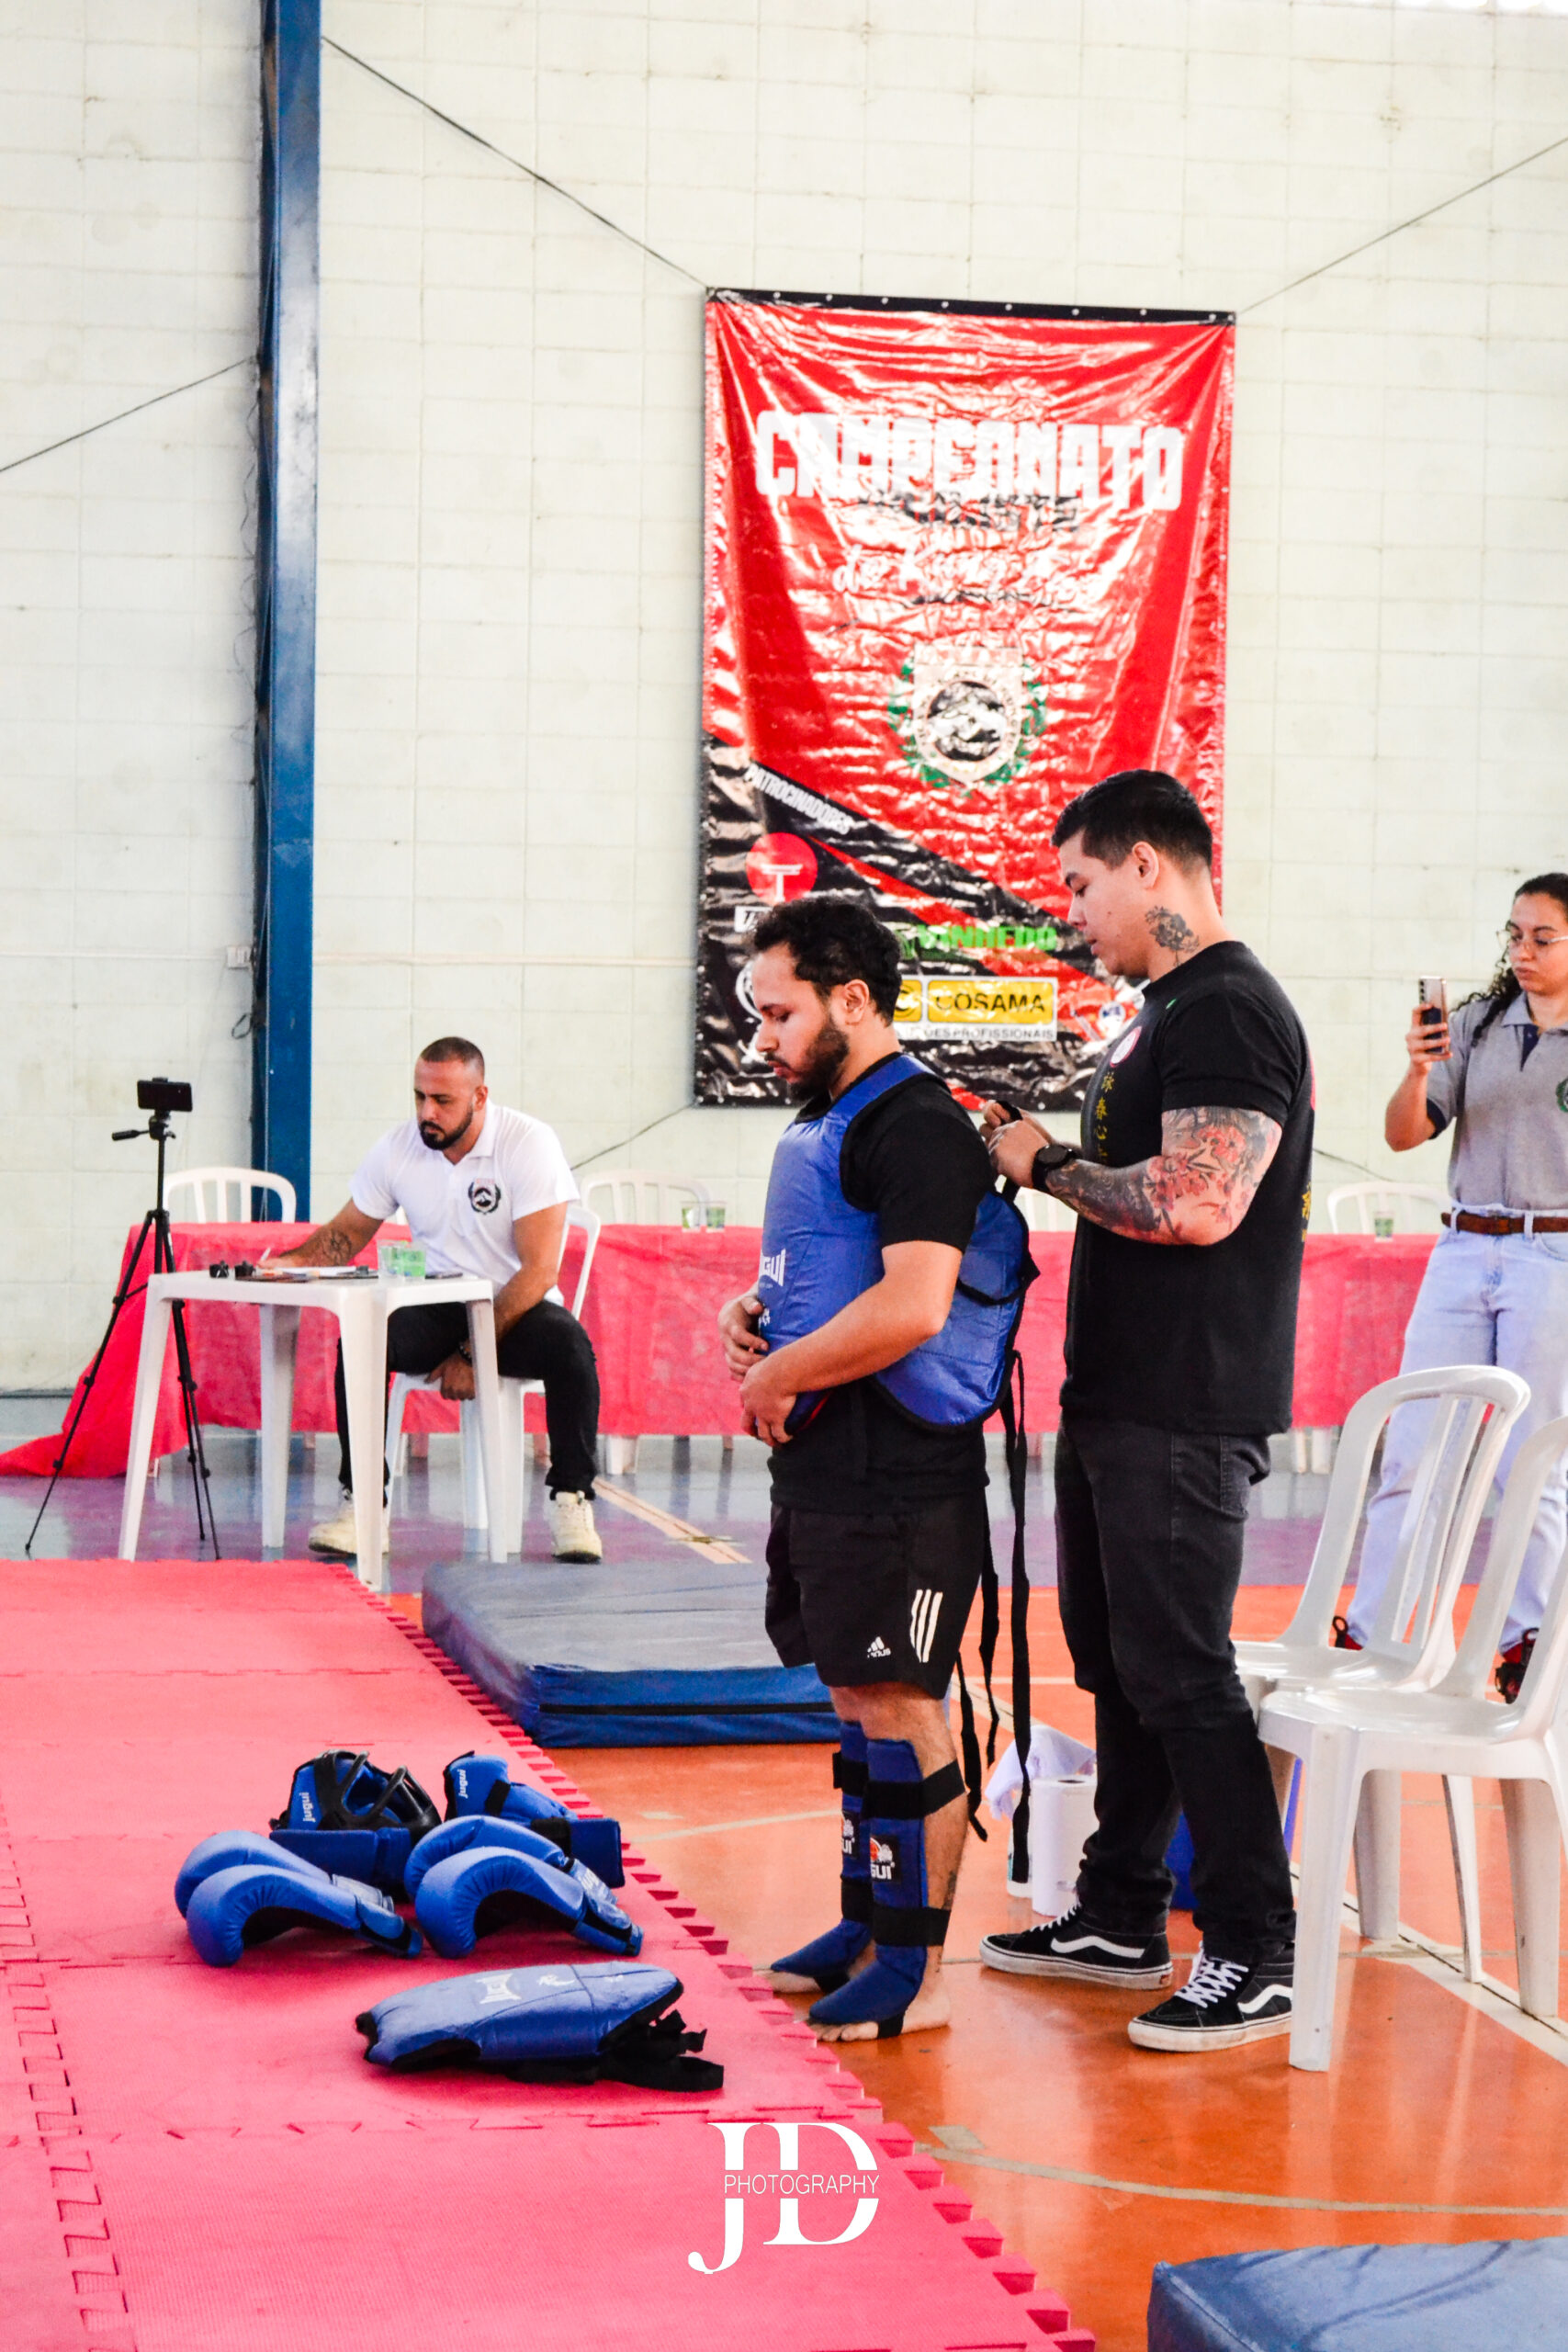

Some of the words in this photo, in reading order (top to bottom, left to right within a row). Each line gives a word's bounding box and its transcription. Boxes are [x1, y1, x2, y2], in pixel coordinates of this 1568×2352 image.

[755, 410, 1184, 511] CAMPEONATO
[744, 763, 854, 835] PATROCINADORES
[935, 992, 1045, 1013] COSAMA
[953, 1027, 1054, 1040] PROFISSIONAIS
